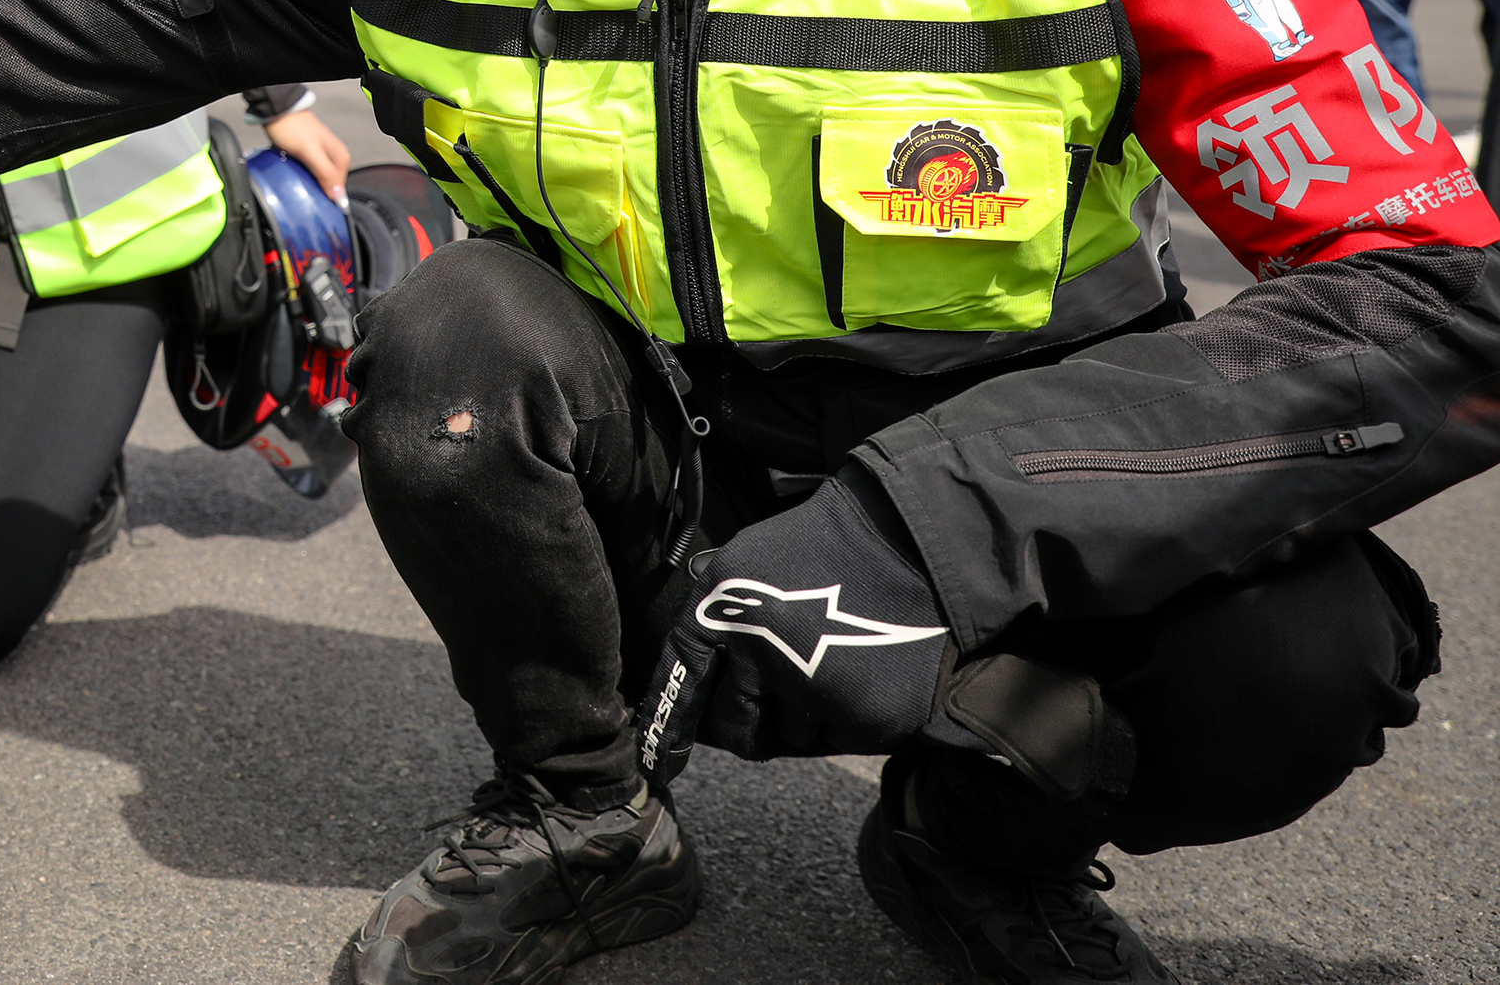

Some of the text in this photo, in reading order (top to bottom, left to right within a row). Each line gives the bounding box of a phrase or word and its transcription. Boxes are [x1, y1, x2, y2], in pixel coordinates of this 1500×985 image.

[897, 146, 917, 183] HENGSHUI
[915, 136, 931, 149] CAR
[937, 133, 966, 144] MOTOR
[965, 141, 994, 187] ASSOCIATION
[881, 187, 1010, 230] 衡水汽摩
[640, 658, 688, 771] alpinestars
